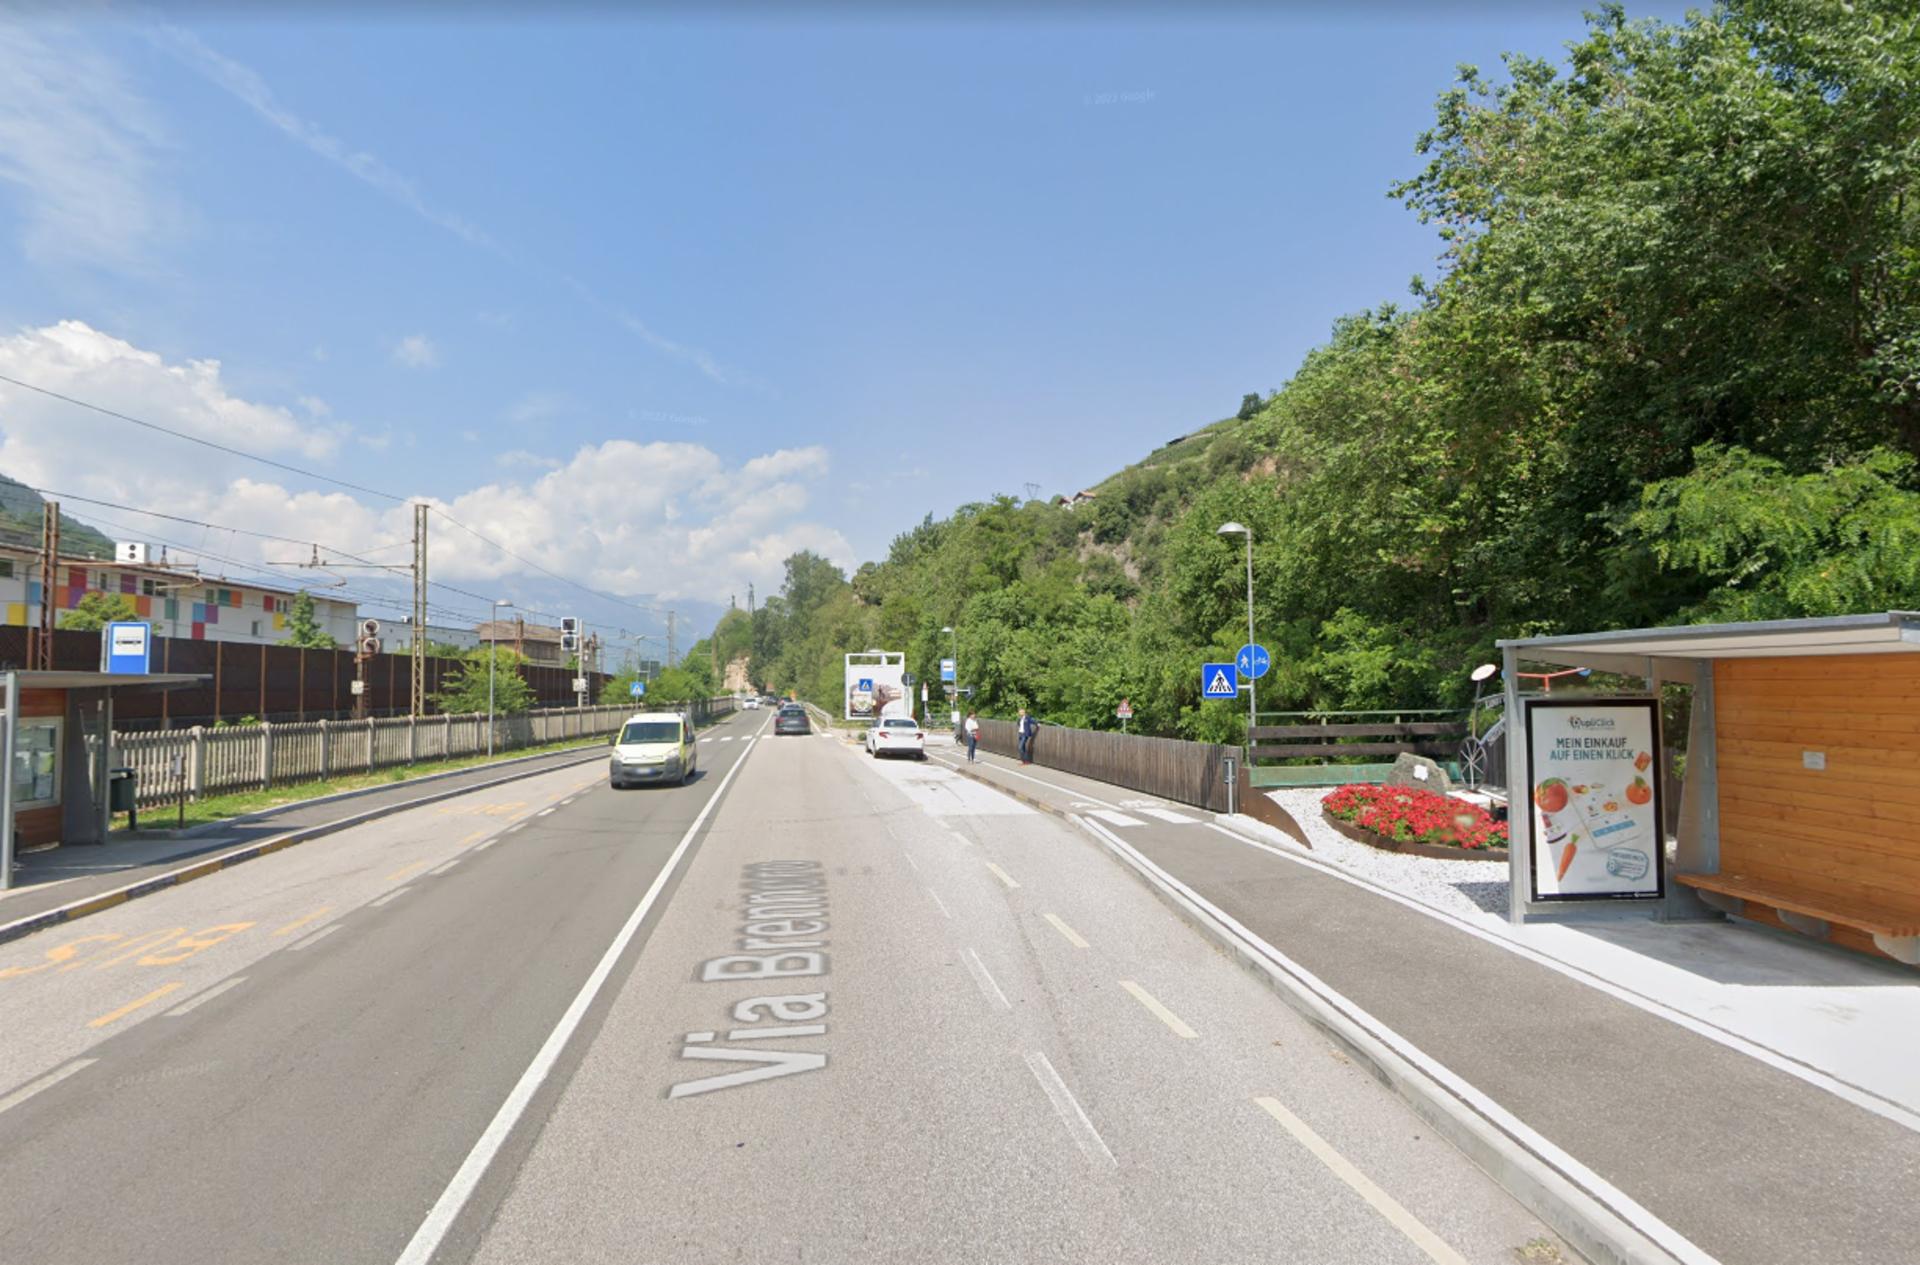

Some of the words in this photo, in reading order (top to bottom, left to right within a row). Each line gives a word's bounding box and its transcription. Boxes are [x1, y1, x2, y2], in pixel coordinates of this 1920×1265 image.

[1556, 737, 1581, 749] MEIN
[1584, 737, 1627, 749] EINKAUF
[1550, 749, 1570, 761] AUF
[1573, 749, 1604, 761] EINEN
[1606, 748, 1635, 760] KLICK
